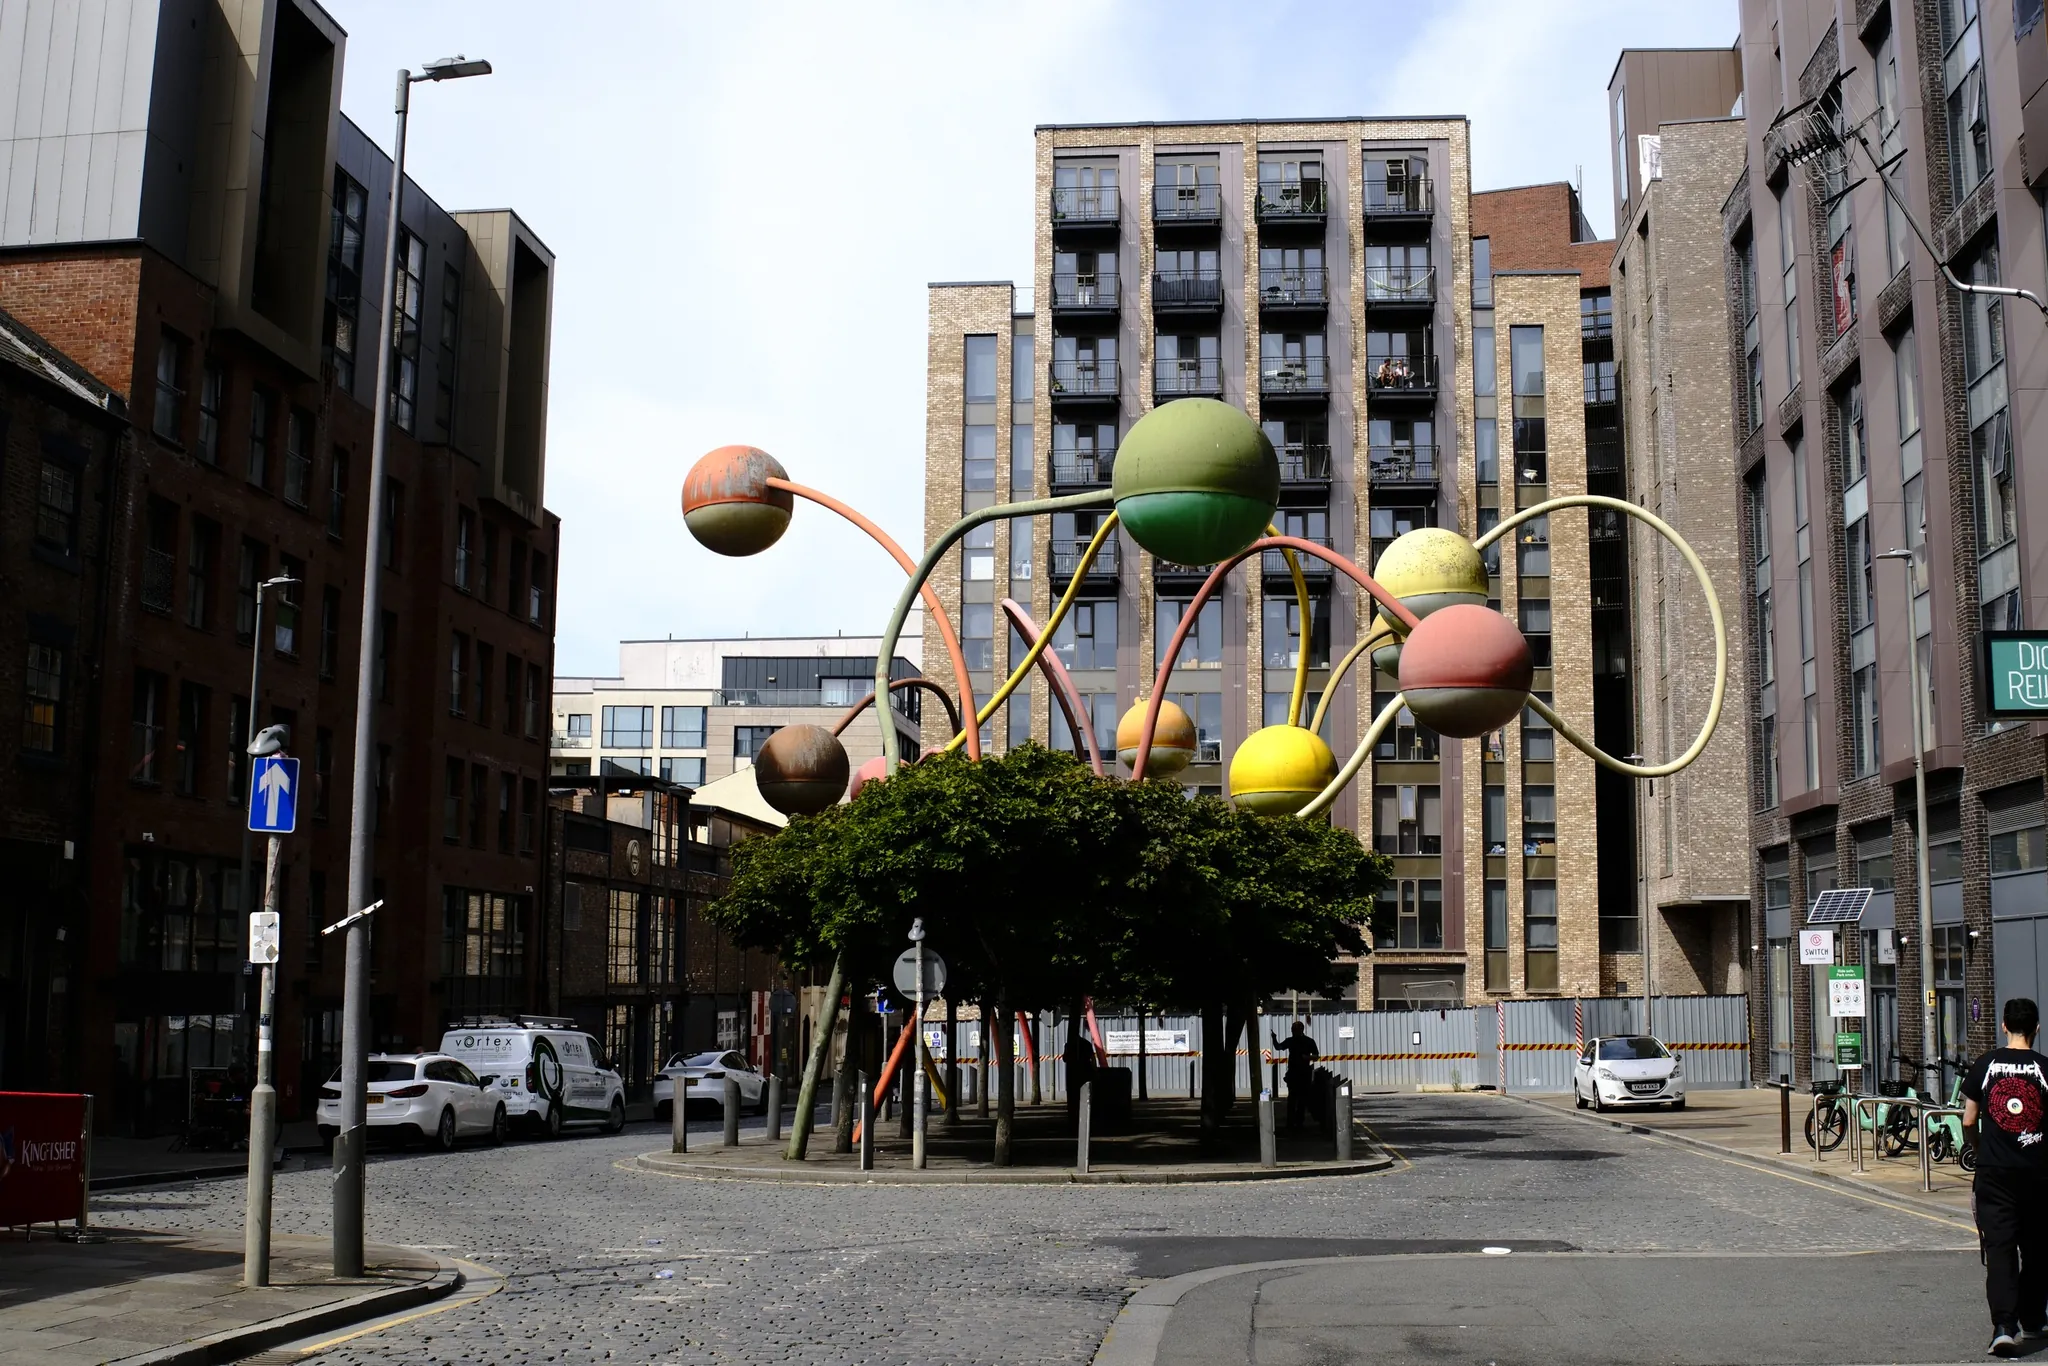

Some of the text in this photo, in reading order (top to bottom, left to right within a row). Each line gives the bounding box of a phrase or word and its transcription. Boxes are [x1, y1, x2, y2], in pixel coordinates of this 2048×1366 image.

[1805, 948, 1829, 956] SWITCH
[455, 1036, 512, 1048] vortex
[561, 1041, 582, 1053] vortex
[1981, 1058, 2048, 1090] METALLICA
